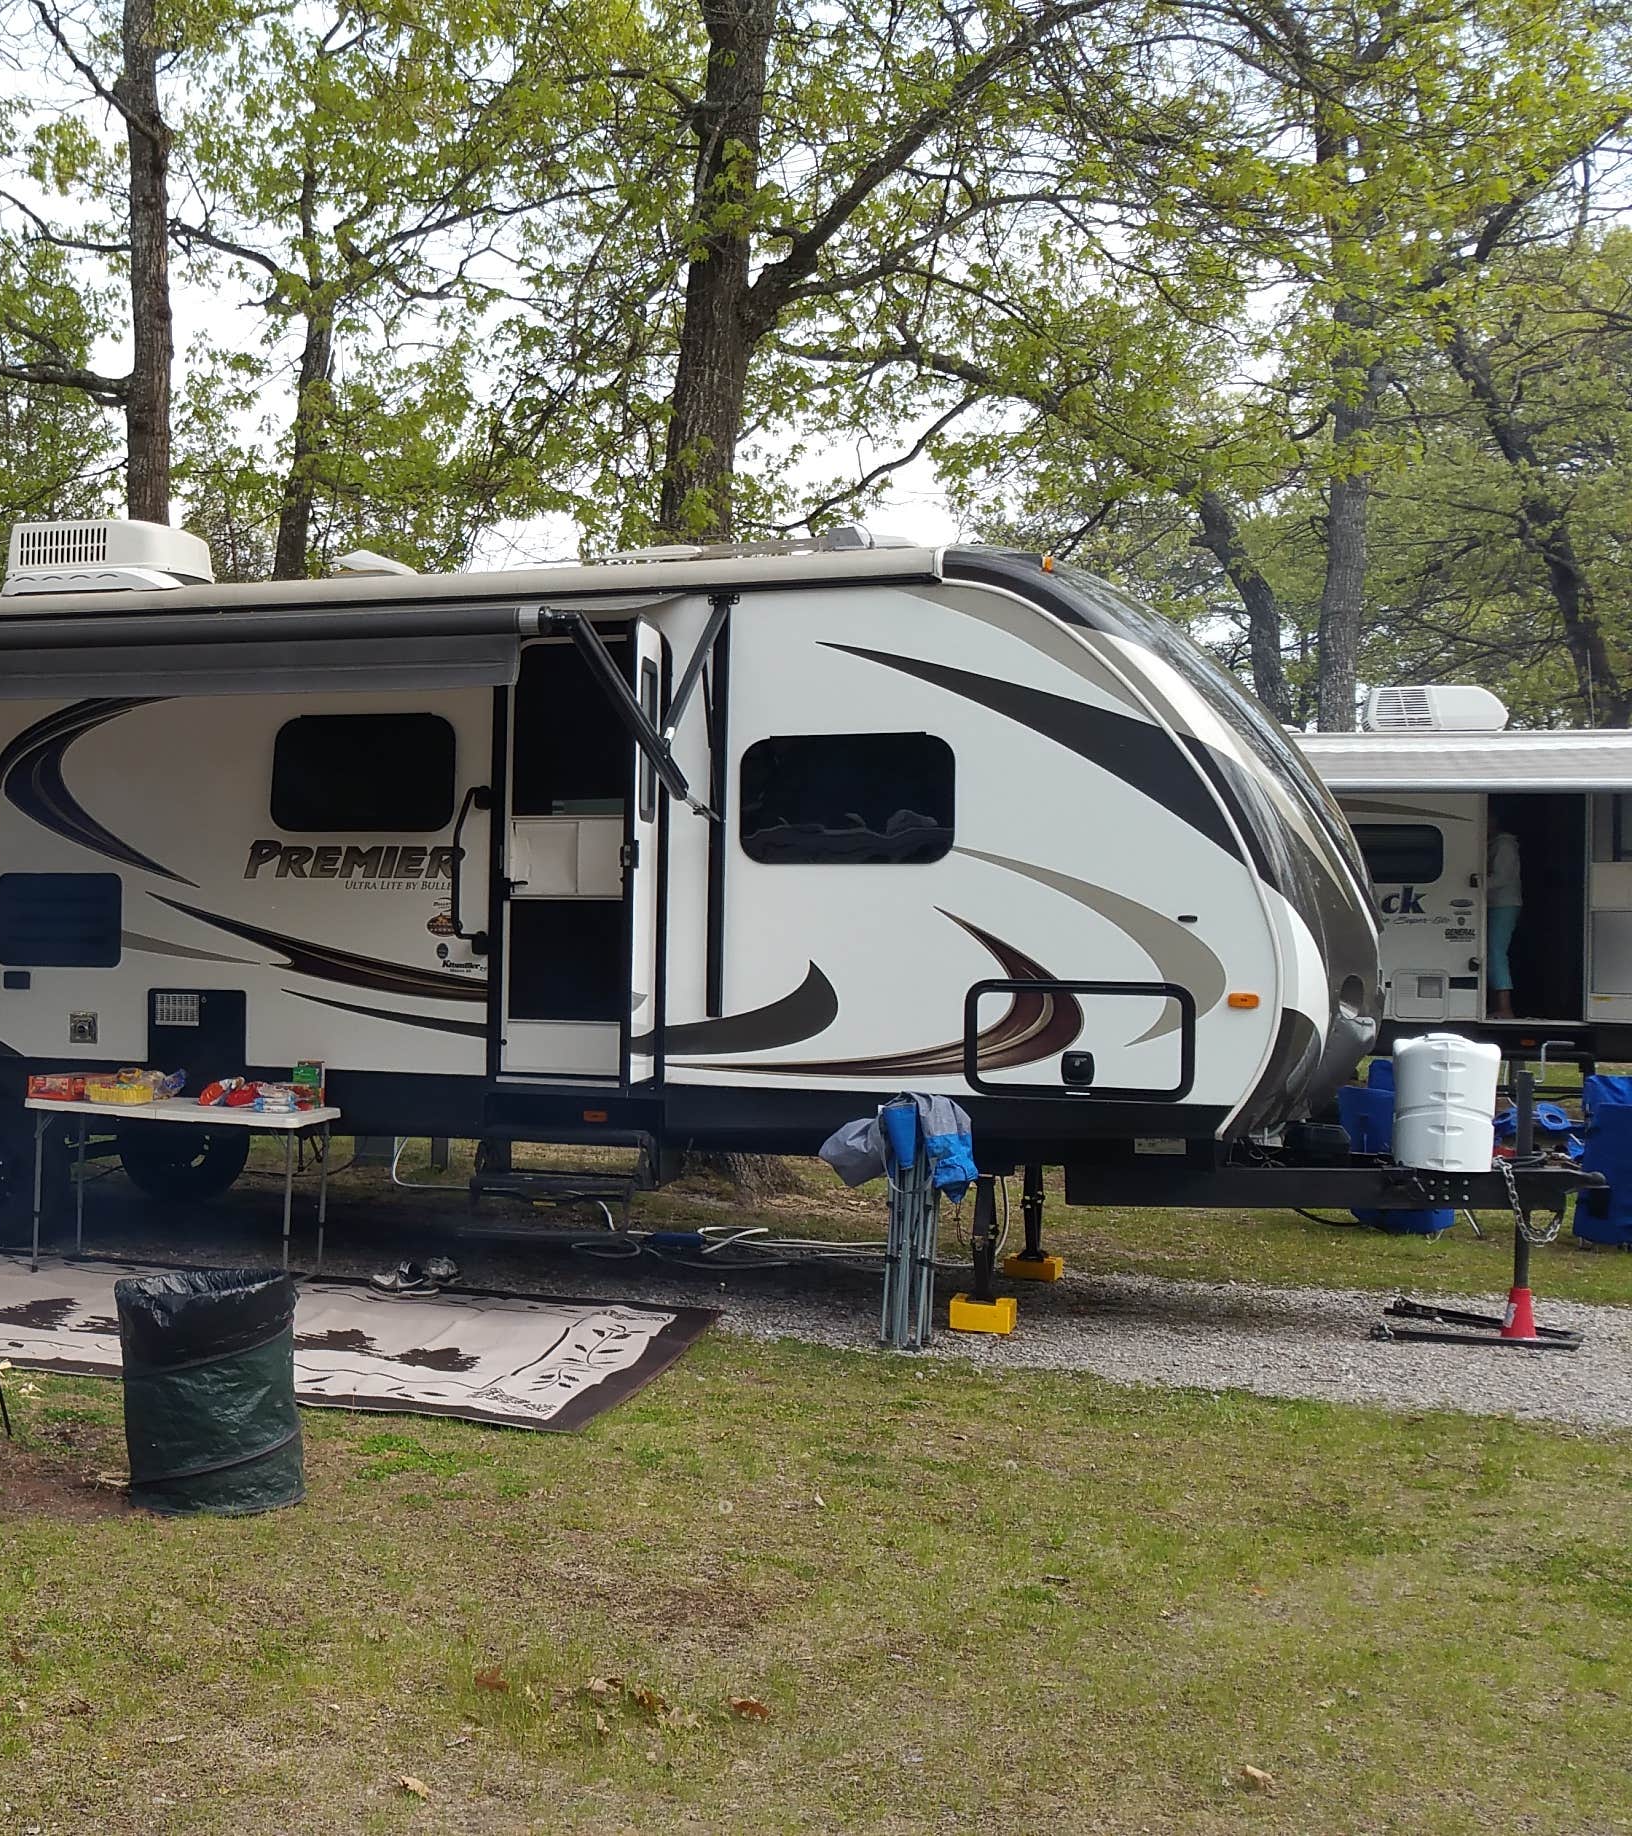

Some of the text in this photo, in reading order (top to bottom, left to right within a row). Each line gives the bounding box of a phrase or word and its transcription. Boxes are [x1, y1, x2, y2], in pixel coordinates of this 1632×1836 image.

[243, 839, 465, 879] PREMIER
[344, 880, 452, 890] ULTRA LITE BY BULL
[1381, 886, 1427, 914] ck
